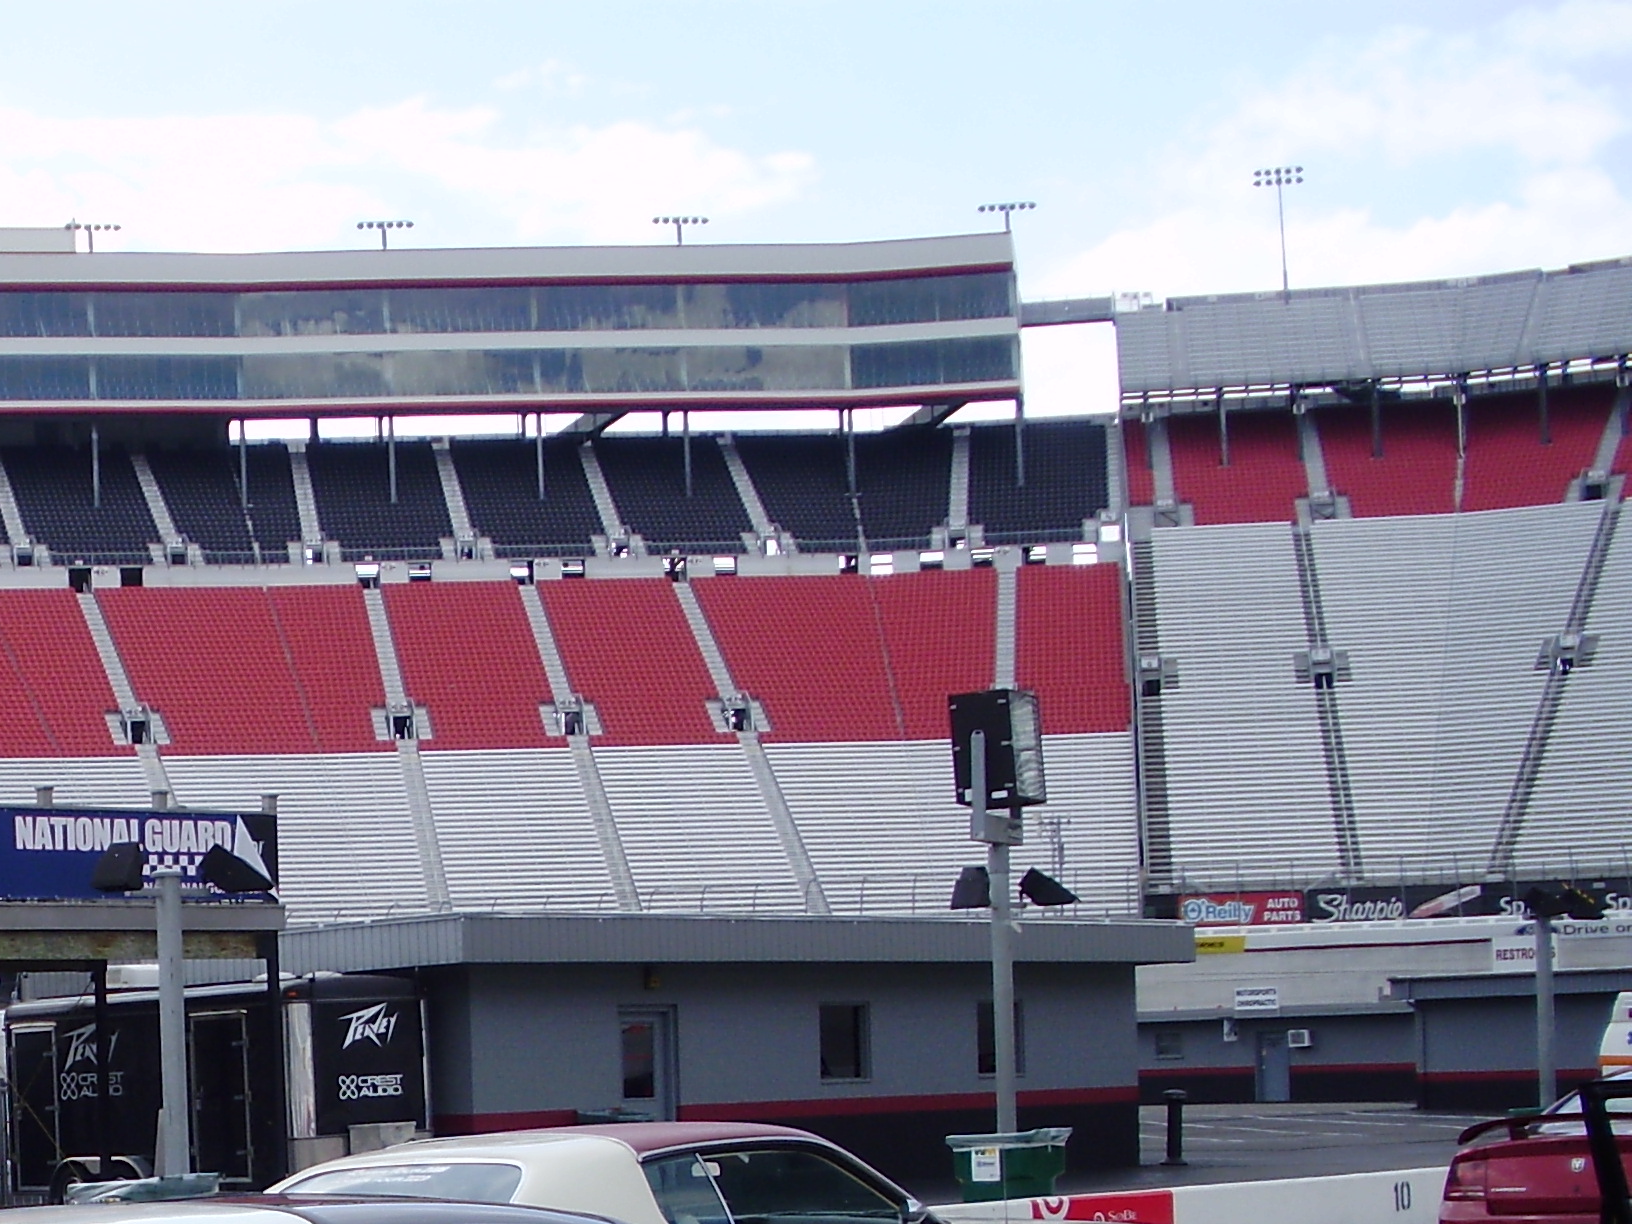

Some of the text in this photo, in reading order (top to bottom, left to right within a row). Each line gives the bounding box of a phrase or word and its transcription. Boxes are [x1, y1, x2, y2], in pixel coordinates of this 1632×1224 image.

[144, 817, 232, 853] GUARD
[1267, 898, 1299, 909] AUTO
[1312, 894, 1406, 923] Sharpie
[1182, 899, 1254, 923] O'Reilly
[1264, 910, 1301, 922] PARTS
[1563, 924, 1609, 936] Drive
[1495, 947, 1557, 961] RESTROS
[78, 1071, 124, 1085] CRST
[357, 1074, 404, 1087] CREST
[359, 1084, 404, 1098] AUDIO
[1394, 1181, 1411, 1212] 10
